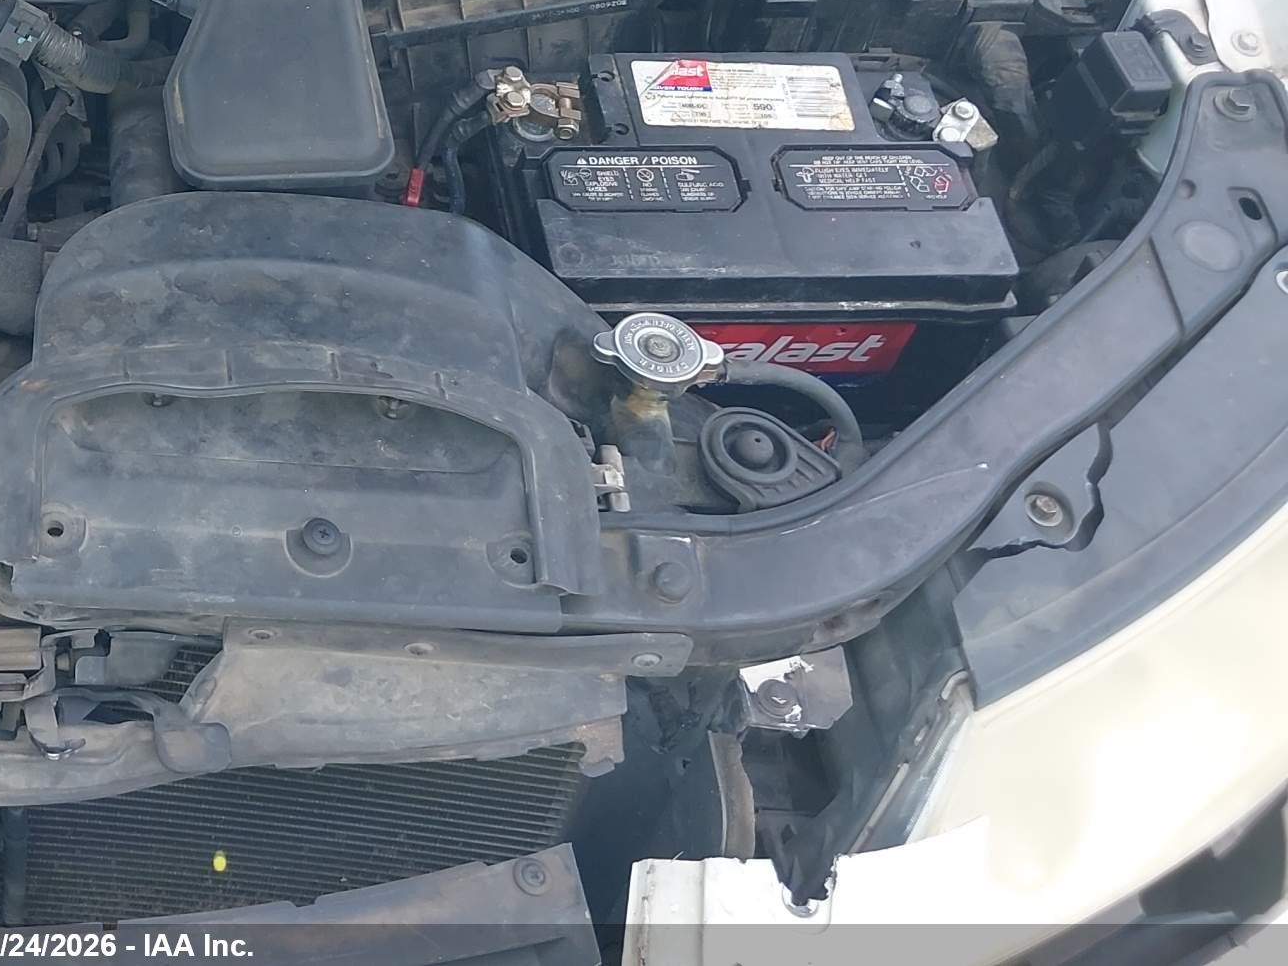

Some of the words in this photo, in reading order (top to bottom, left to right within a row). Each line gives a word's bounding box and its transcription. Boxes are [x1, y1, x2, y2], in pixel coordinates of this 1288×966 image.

[589, 157, 639, 165] DANGER
[642, 157, 648, 165] /
[651, 157, 697, 165] POISON
